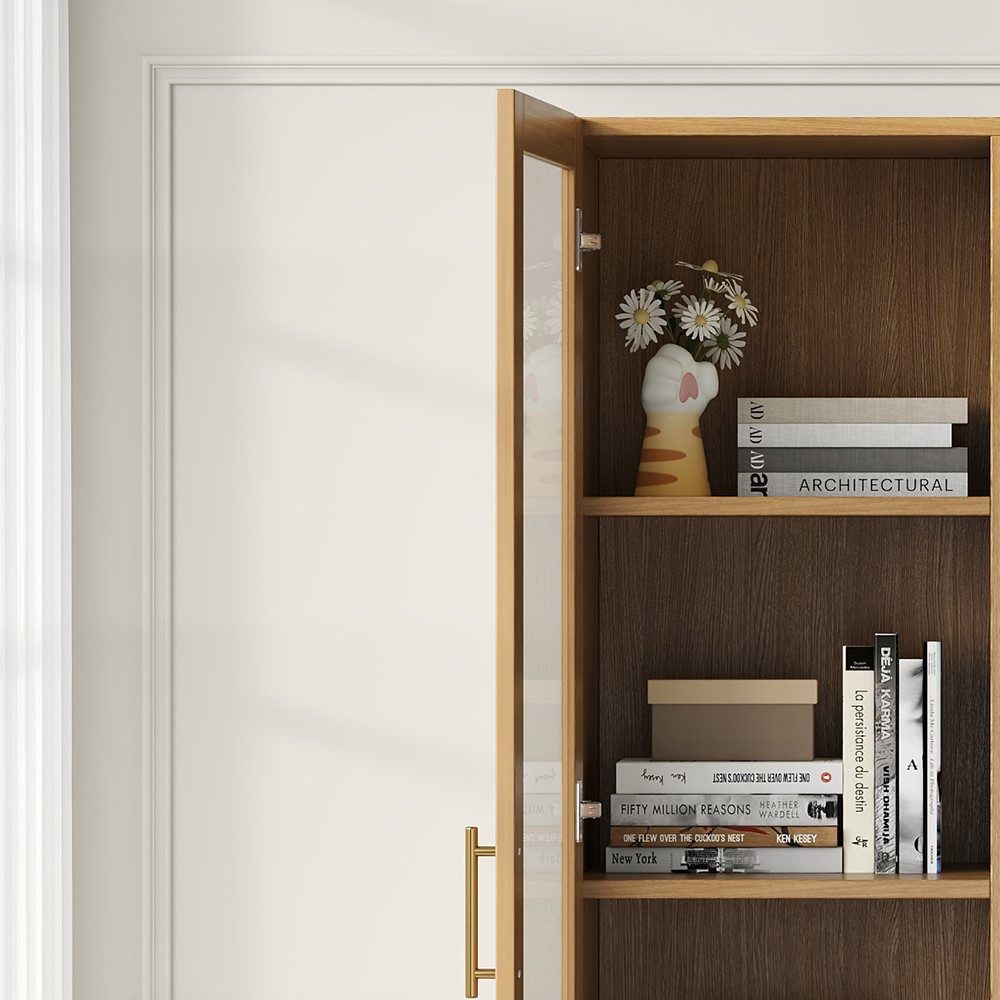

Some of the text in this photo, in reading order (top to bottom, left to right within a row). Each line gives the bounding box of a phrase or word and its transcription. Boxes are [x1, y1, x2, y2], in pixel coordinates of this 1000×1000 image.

[799, 478, 954, 492] ARCHITECTURAL
[880, 688, 892, 740] KARMA
[851, 689, 869, 813] La persistance du destin
[712, 773, 727, 783] NEST
[755, 773, 767, 783] THE
[767, 773, 783, 783] OVER
[783, 773, 798, 783] FLEW
[799, 773, 811, 783] ONE
[882, 765, 890, 793] VISH
[620, 803, 752, 816] FIFTY MILLION REASONS
[759, 801, 799, 810] HEATHER
[758, 810, 801, 819] WARDELL
[881, 795, 890, 845] DHAMIJA
[623, 833, 818, 843] ONE FLEW OVER THE CUCKOO'S NEST KEN KESEY
[611, 852, 633, 865] New
[635, 851, 658, 865] York
